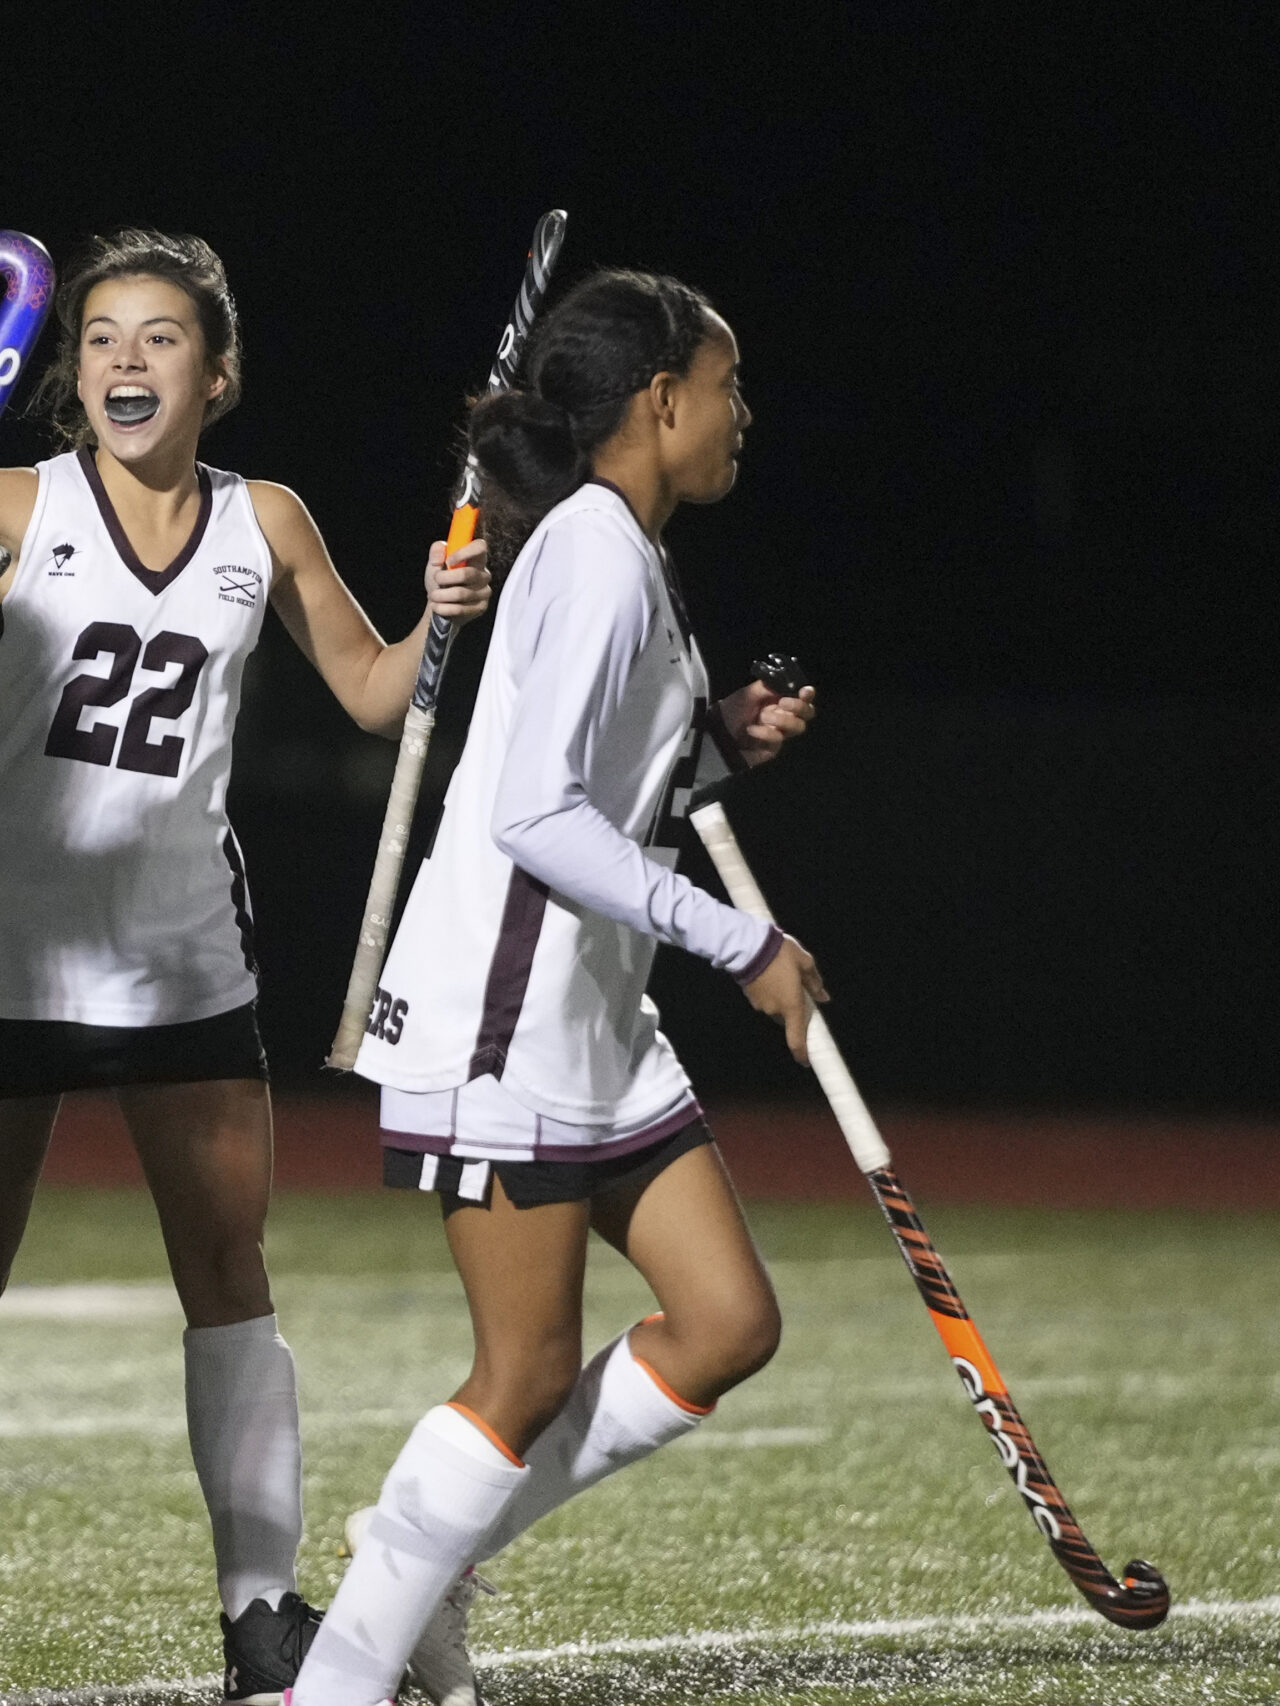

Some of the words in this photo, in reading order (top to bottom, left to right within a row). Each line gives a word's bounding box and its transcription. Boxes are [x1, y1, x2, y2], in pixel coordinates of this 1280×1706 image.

[212, 564, 262, 584] SOUTHAMPTON
[218, 593, 235, 603] FIELD
[43, 621, 209, 778] 22
